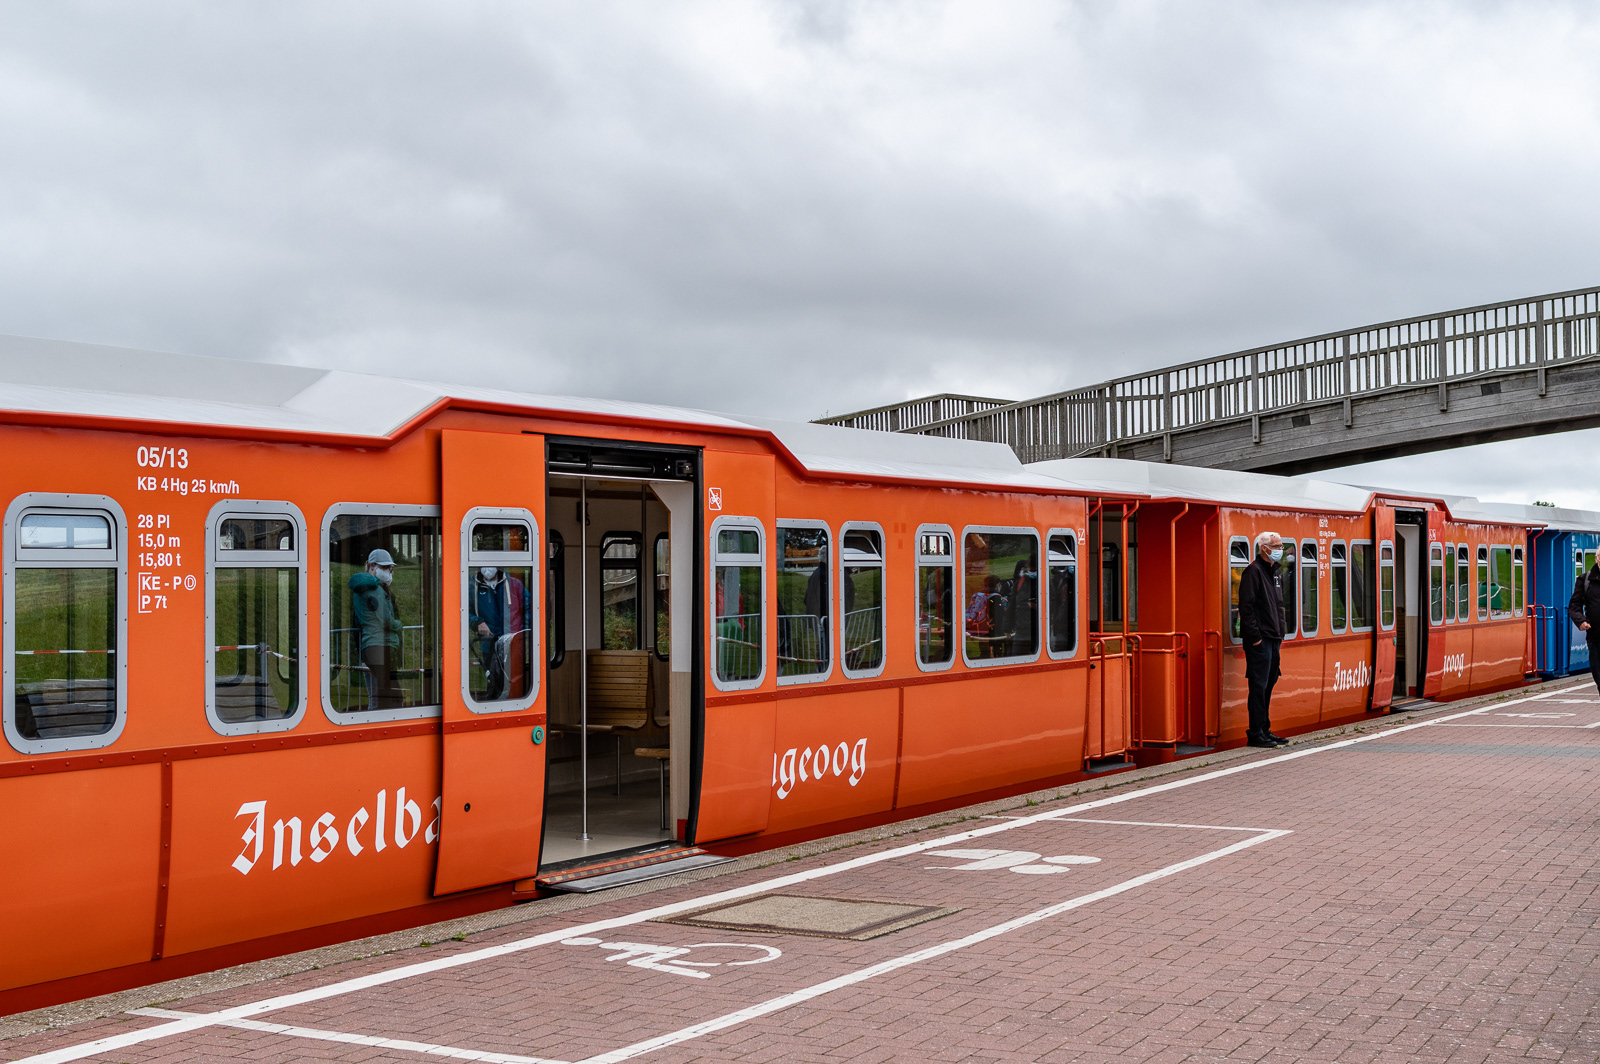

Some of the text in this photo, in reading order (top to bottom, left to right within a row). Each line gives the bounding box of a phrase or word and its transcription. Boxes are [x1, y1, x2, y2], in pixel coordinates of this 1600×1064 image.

[137, 446, 189, 469] 05/13
[137, 476, 157, 491] KB
[191, 479, 207, 493] 25
[209, 480, 240, 494] km/h
[137, 514, 154, 529] 28
[138, 533, 181, 550] 15,0 m
[138, 553, 182, 570] 15,80 t
[142, 576, 161, 591] KE
[173, 576, 182, 590] P
[142, 595, 151, 609] P
